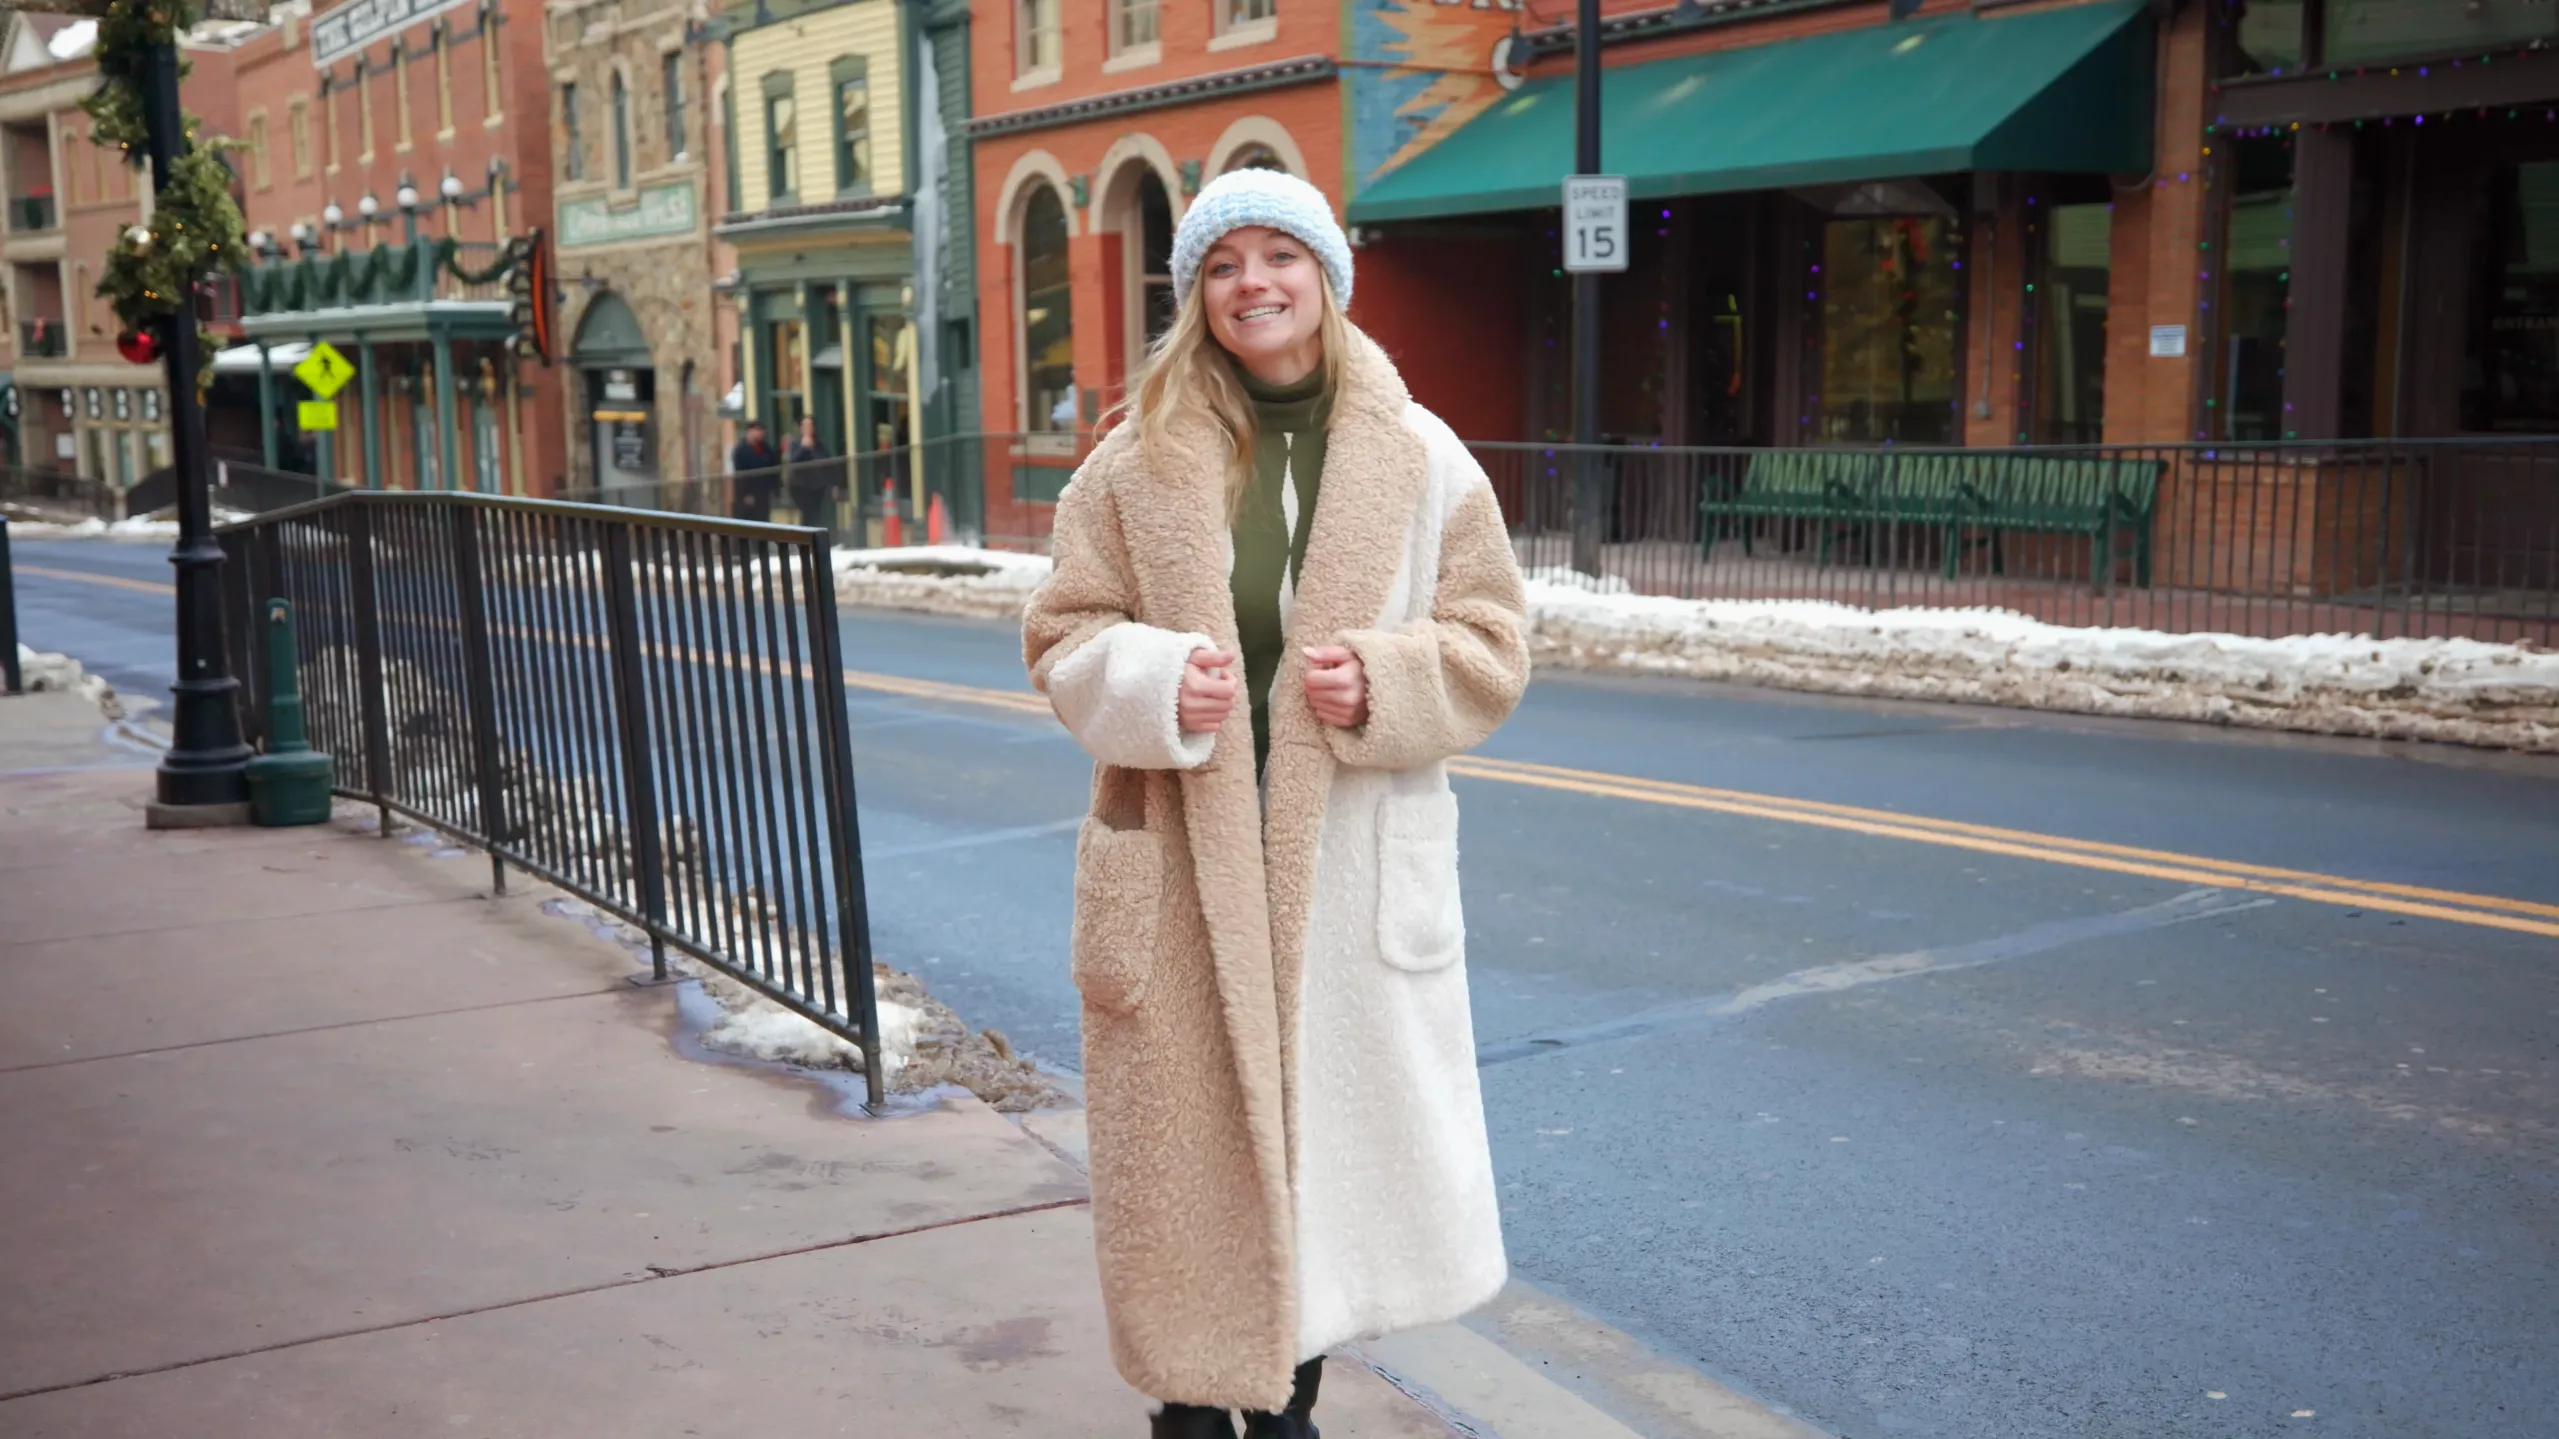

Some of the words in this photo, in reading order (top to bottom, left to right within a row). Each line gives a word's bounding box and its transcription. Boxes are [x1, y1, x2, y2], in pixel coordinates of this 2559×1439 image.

[1572, 186, 1621, 200] SPEED
[1576, 205, 1615, 220] LIMIT
[1577, 226, 1615, 259] 15
